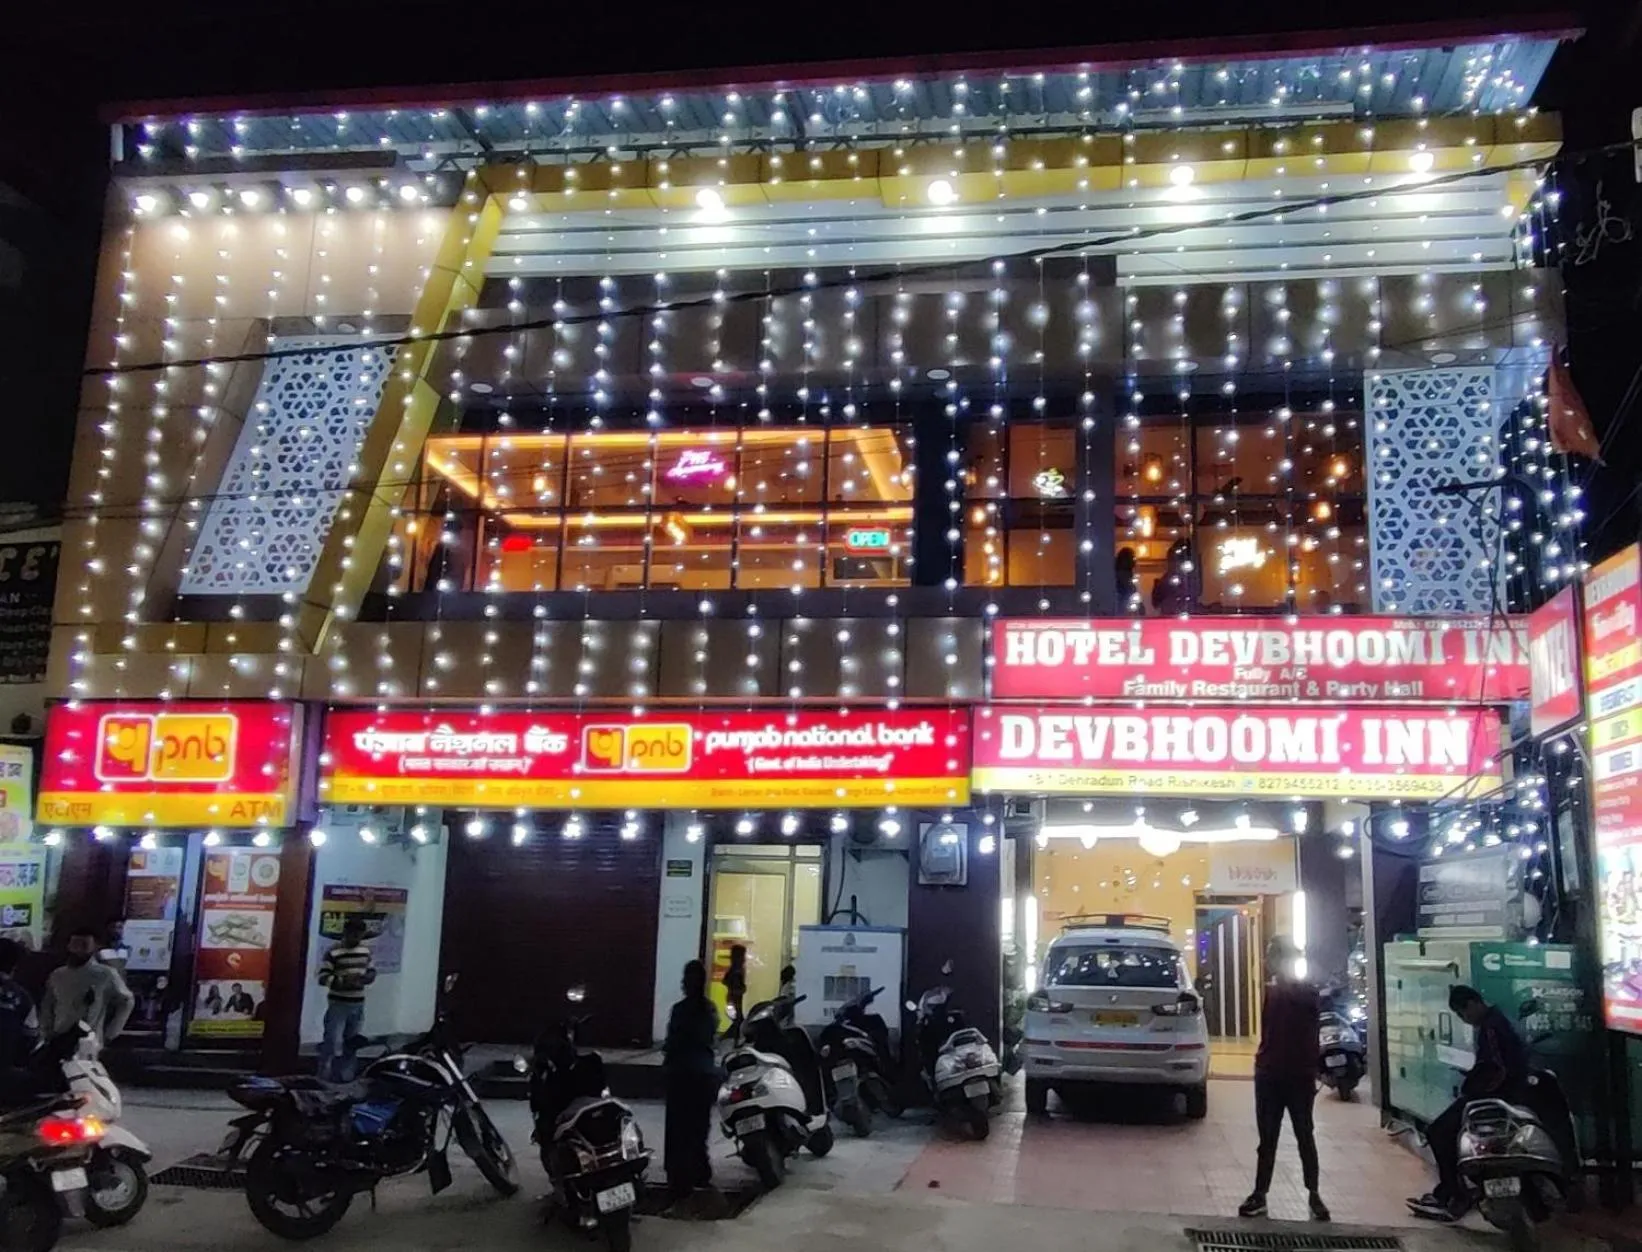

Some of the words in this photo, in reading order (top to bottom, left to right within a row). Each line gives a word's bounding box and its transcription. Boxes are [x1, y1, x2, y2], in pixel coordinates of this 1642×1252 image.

[849, 530, 890, 548] OPEN
[1005, 630, 1155, 667] HOTEL
[1169, 629, 1447, 667] DEVBHOOMI
[1124, 680, 1186, 698] Family
[1191, 680, 1300, 698] Restaurant
[1306, 681, 1320, 696] &
[1326, 681, 1378, 699] Party
[1384, 681, 1424, 697] Hall
[157, 725, 226, 771] pnb
[630, 731, 684, 765] pnb
[704, 724, 782, 755] punjab
[877, 721, 935, 746] bank
[999, 714, 1341, 763] DEVBHOOMI
[1361, 718, 1470, 766] INN
[230, 800, 282, 819] ATM
